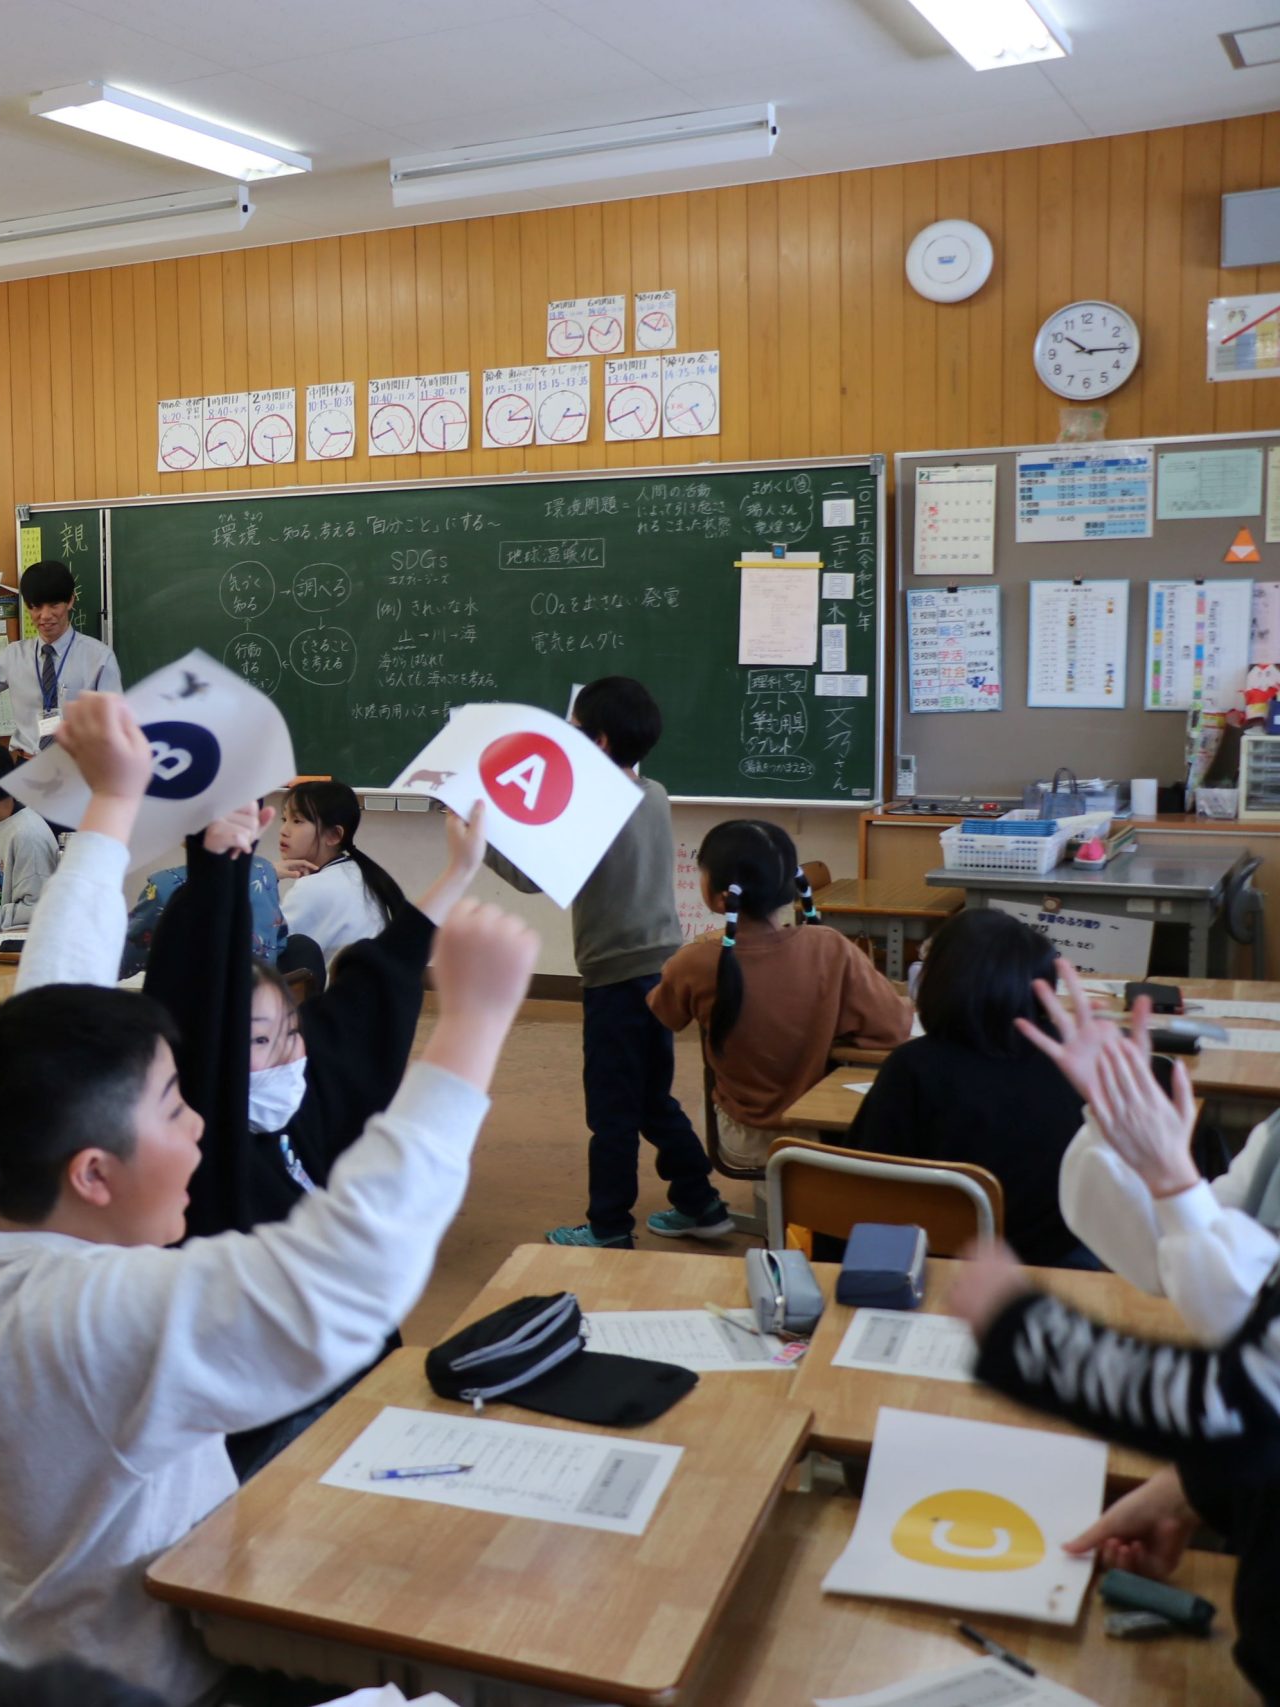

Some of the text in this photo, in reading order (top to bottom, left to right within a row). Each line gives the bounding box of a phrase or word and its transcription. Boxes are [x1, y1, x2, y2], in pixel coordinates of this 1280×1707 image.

[1065, 320, 1074, 330] 11
[1081, 313, 1093, 325] 12
[1102, 316, 1107, 327] 1
[1052, 332, 1064, 343] 10
[1112, 326, 1121, 338] 2
[1048, 349, 1056, 360] 9
[1118, 342, 1127, 354] 3
[608, 360, 647, 374] 5時間目
[1053, 364, 1062, 375] 8
[1112, 360, 1121, 369] 4
[421, 374, 457, 388] 4時間目
[1066, 374, 1075, 386] 7
[1082, 378, 1091, 389] 6
[1100, 372, 1108, 383] 5
[308, 385, 350, 399] 中間休み
[371, 379, 410, 393] 3時間目
[207, 395, 239, 407] 1時間目
[252, 390, 290, 404] 2時間目
[391, 549, 449, 571] SDGs
[506, 545, 599, 565] 地球温暖化
[228, 574, 262, 593] 気づく
[296, 577, 346, 598] 調べる
[233, 596, 257, 614] 知る
[235, 642, 262, 660] 行動
[241, 660, 259, 675] する
[302, 655, 343, 672] を考える
[150, 741, 193, 781] B
[495, 752, 548, 811] A
[931, 1519, 1012, 1559] C
